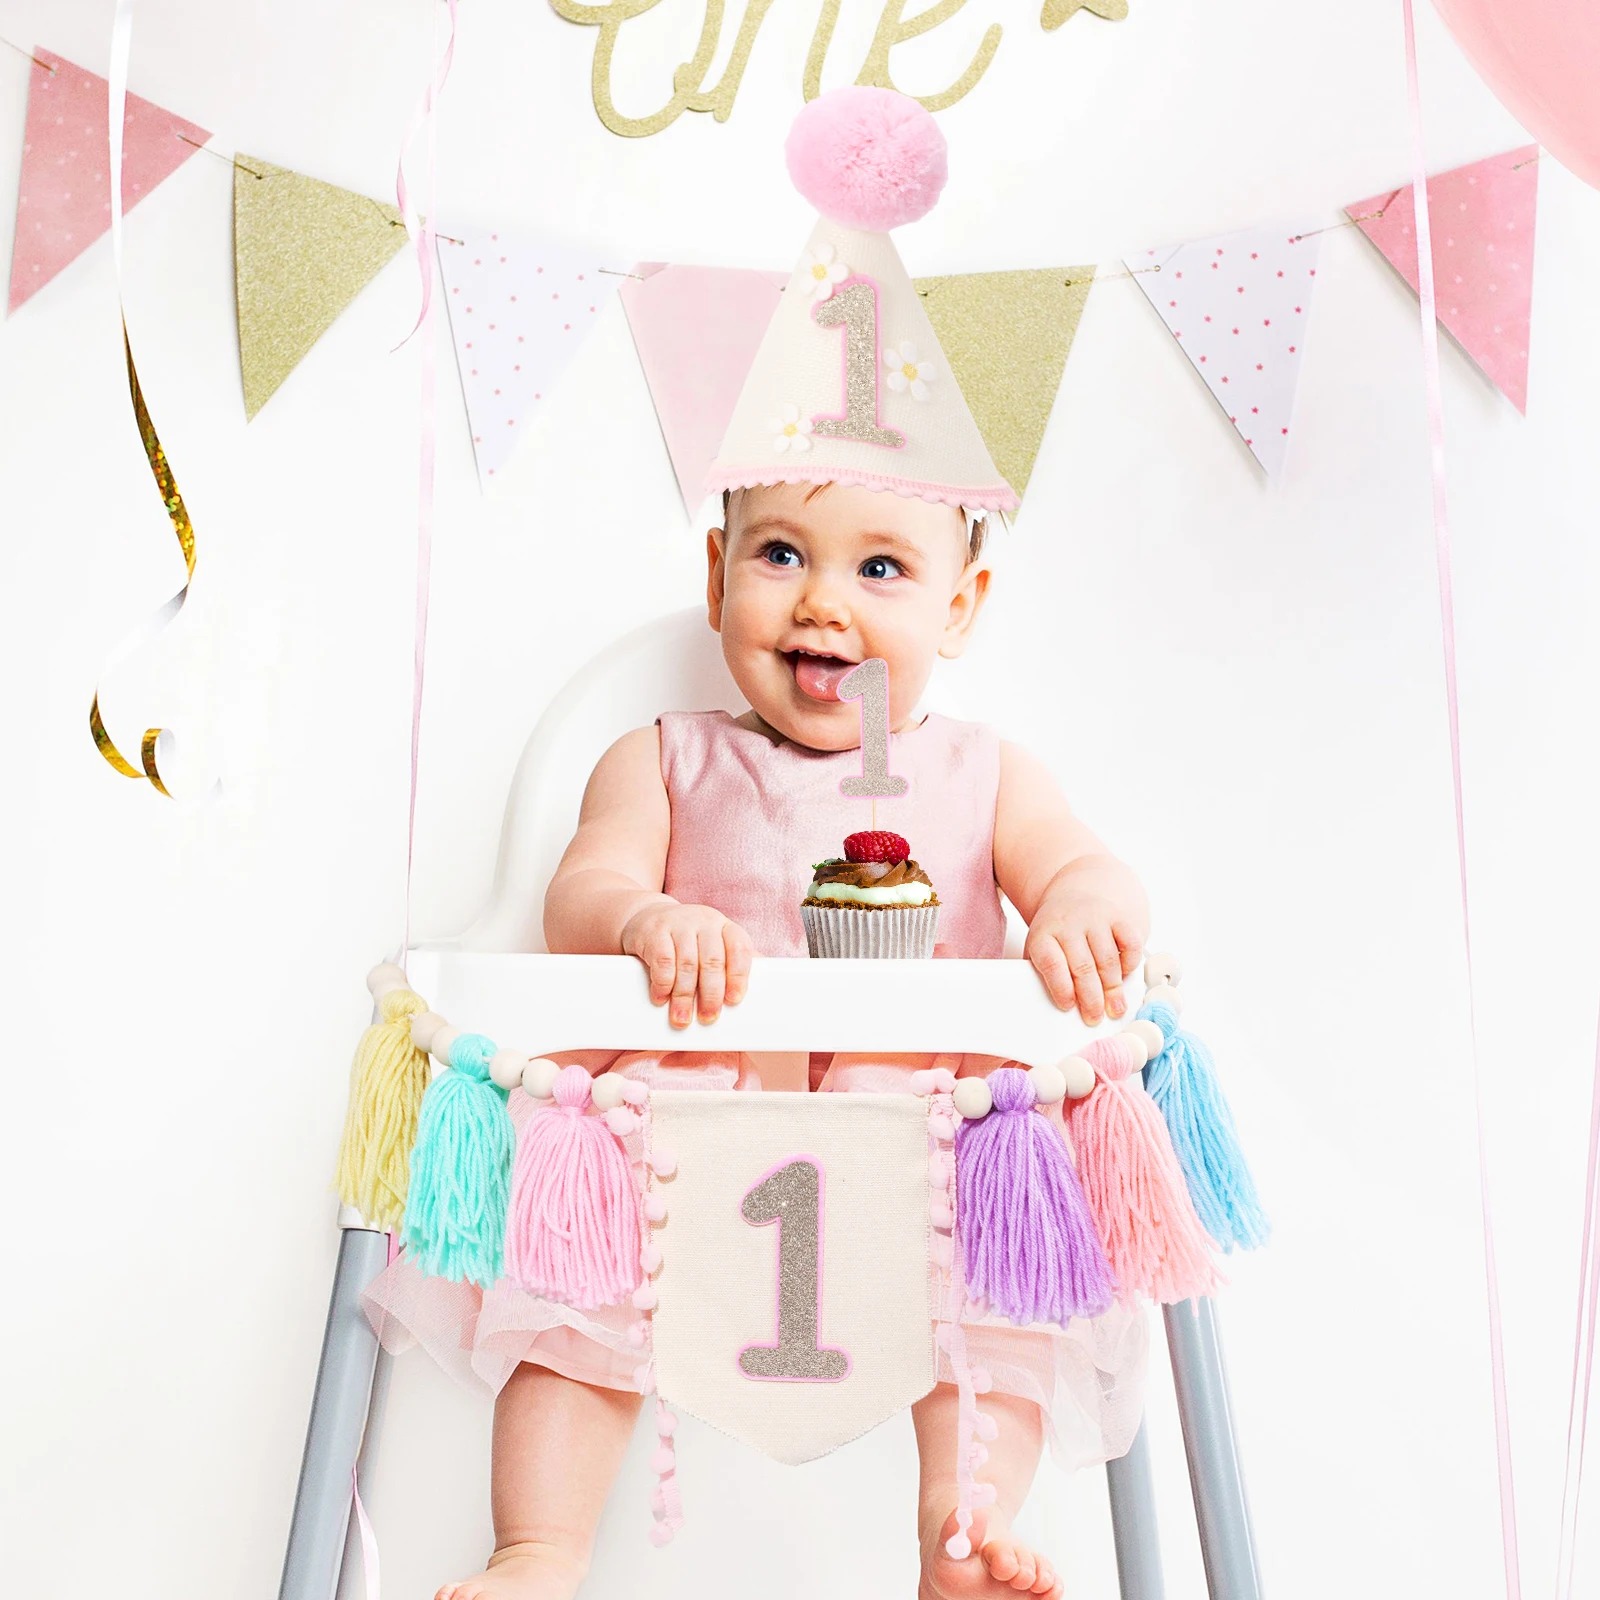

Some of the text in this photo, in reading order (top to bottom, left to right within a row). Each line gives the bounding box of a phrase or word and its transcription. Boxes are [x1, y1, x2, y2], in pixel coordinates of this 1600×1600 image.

[811, 274, 906, 448] 1
[836, 657, 909, 799] 1
[737, 1154, 852, 1383] 1
